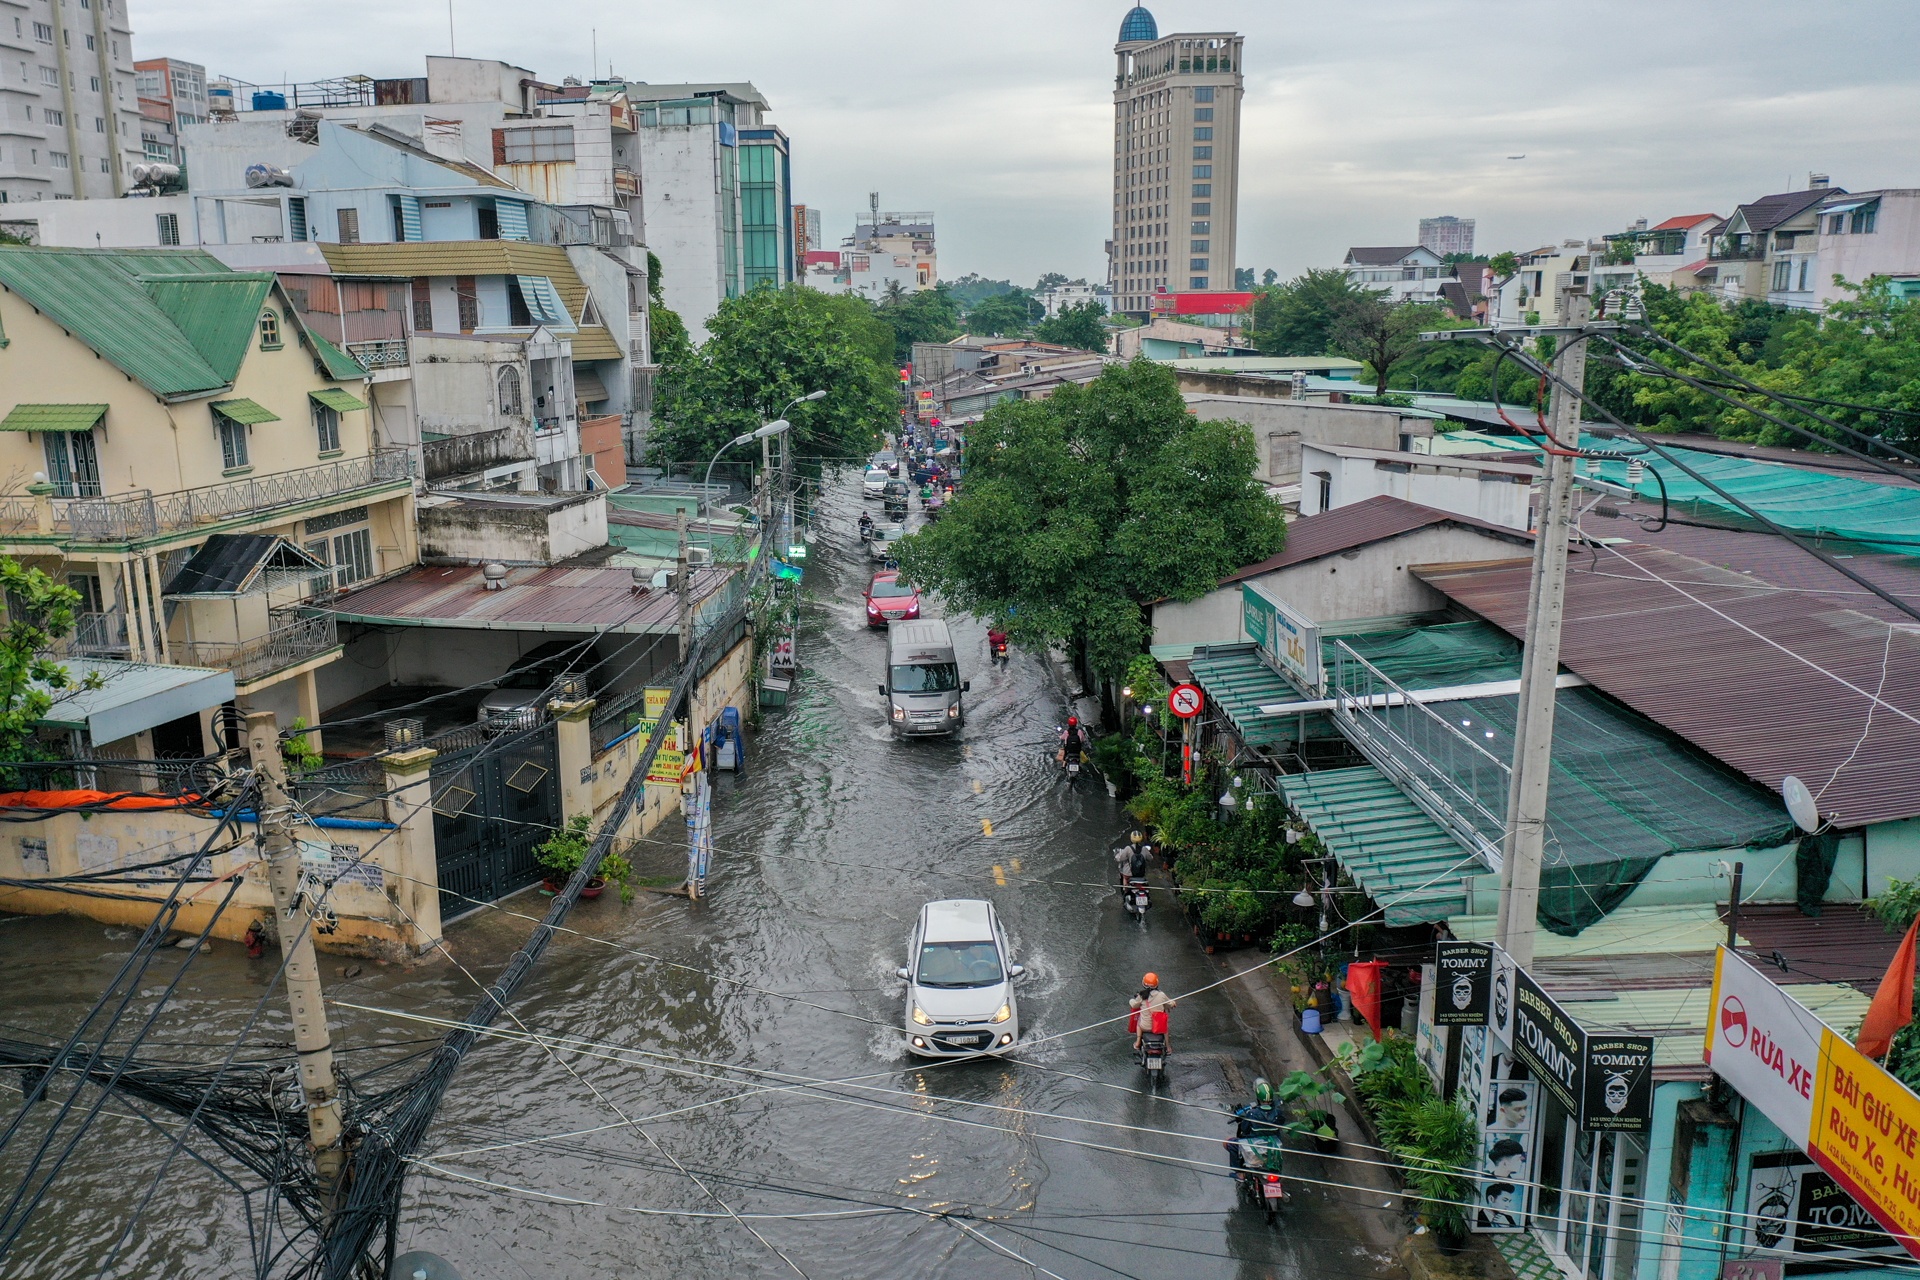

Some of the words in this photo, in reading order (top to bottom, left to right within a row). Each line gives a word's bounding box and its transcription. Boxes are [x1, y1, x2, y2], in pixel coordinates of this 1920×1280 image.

[1441, 958, 1488, 969] TOMMY
[1442, 948, 1469, 957] BARBER
[1470, 947, 1488, 956] SHOP
[1519, 987, 1552, 1023] BARBER
[1554, 1015, 1578, 1054] SHOP
[1518, 1008, 1577, 1090] TOMMY
[1591, 1054, 1647, 1066] TOMMY
[1592, 1043, 1625, 1052] BARBER
[1626, 1043, 1648, 1052] SHOP
[1750, 1026, 1785, 1079] RỬA
[1787, 1057, 1812, 1100] XE
[1829, 1105, 1859, 1152] Rửa
[1862, 1135, 1889, 1186] Xe,
[1893, 1117, 1918, 1160] XE
[1809, 1203, 1878, 1230] TOM
